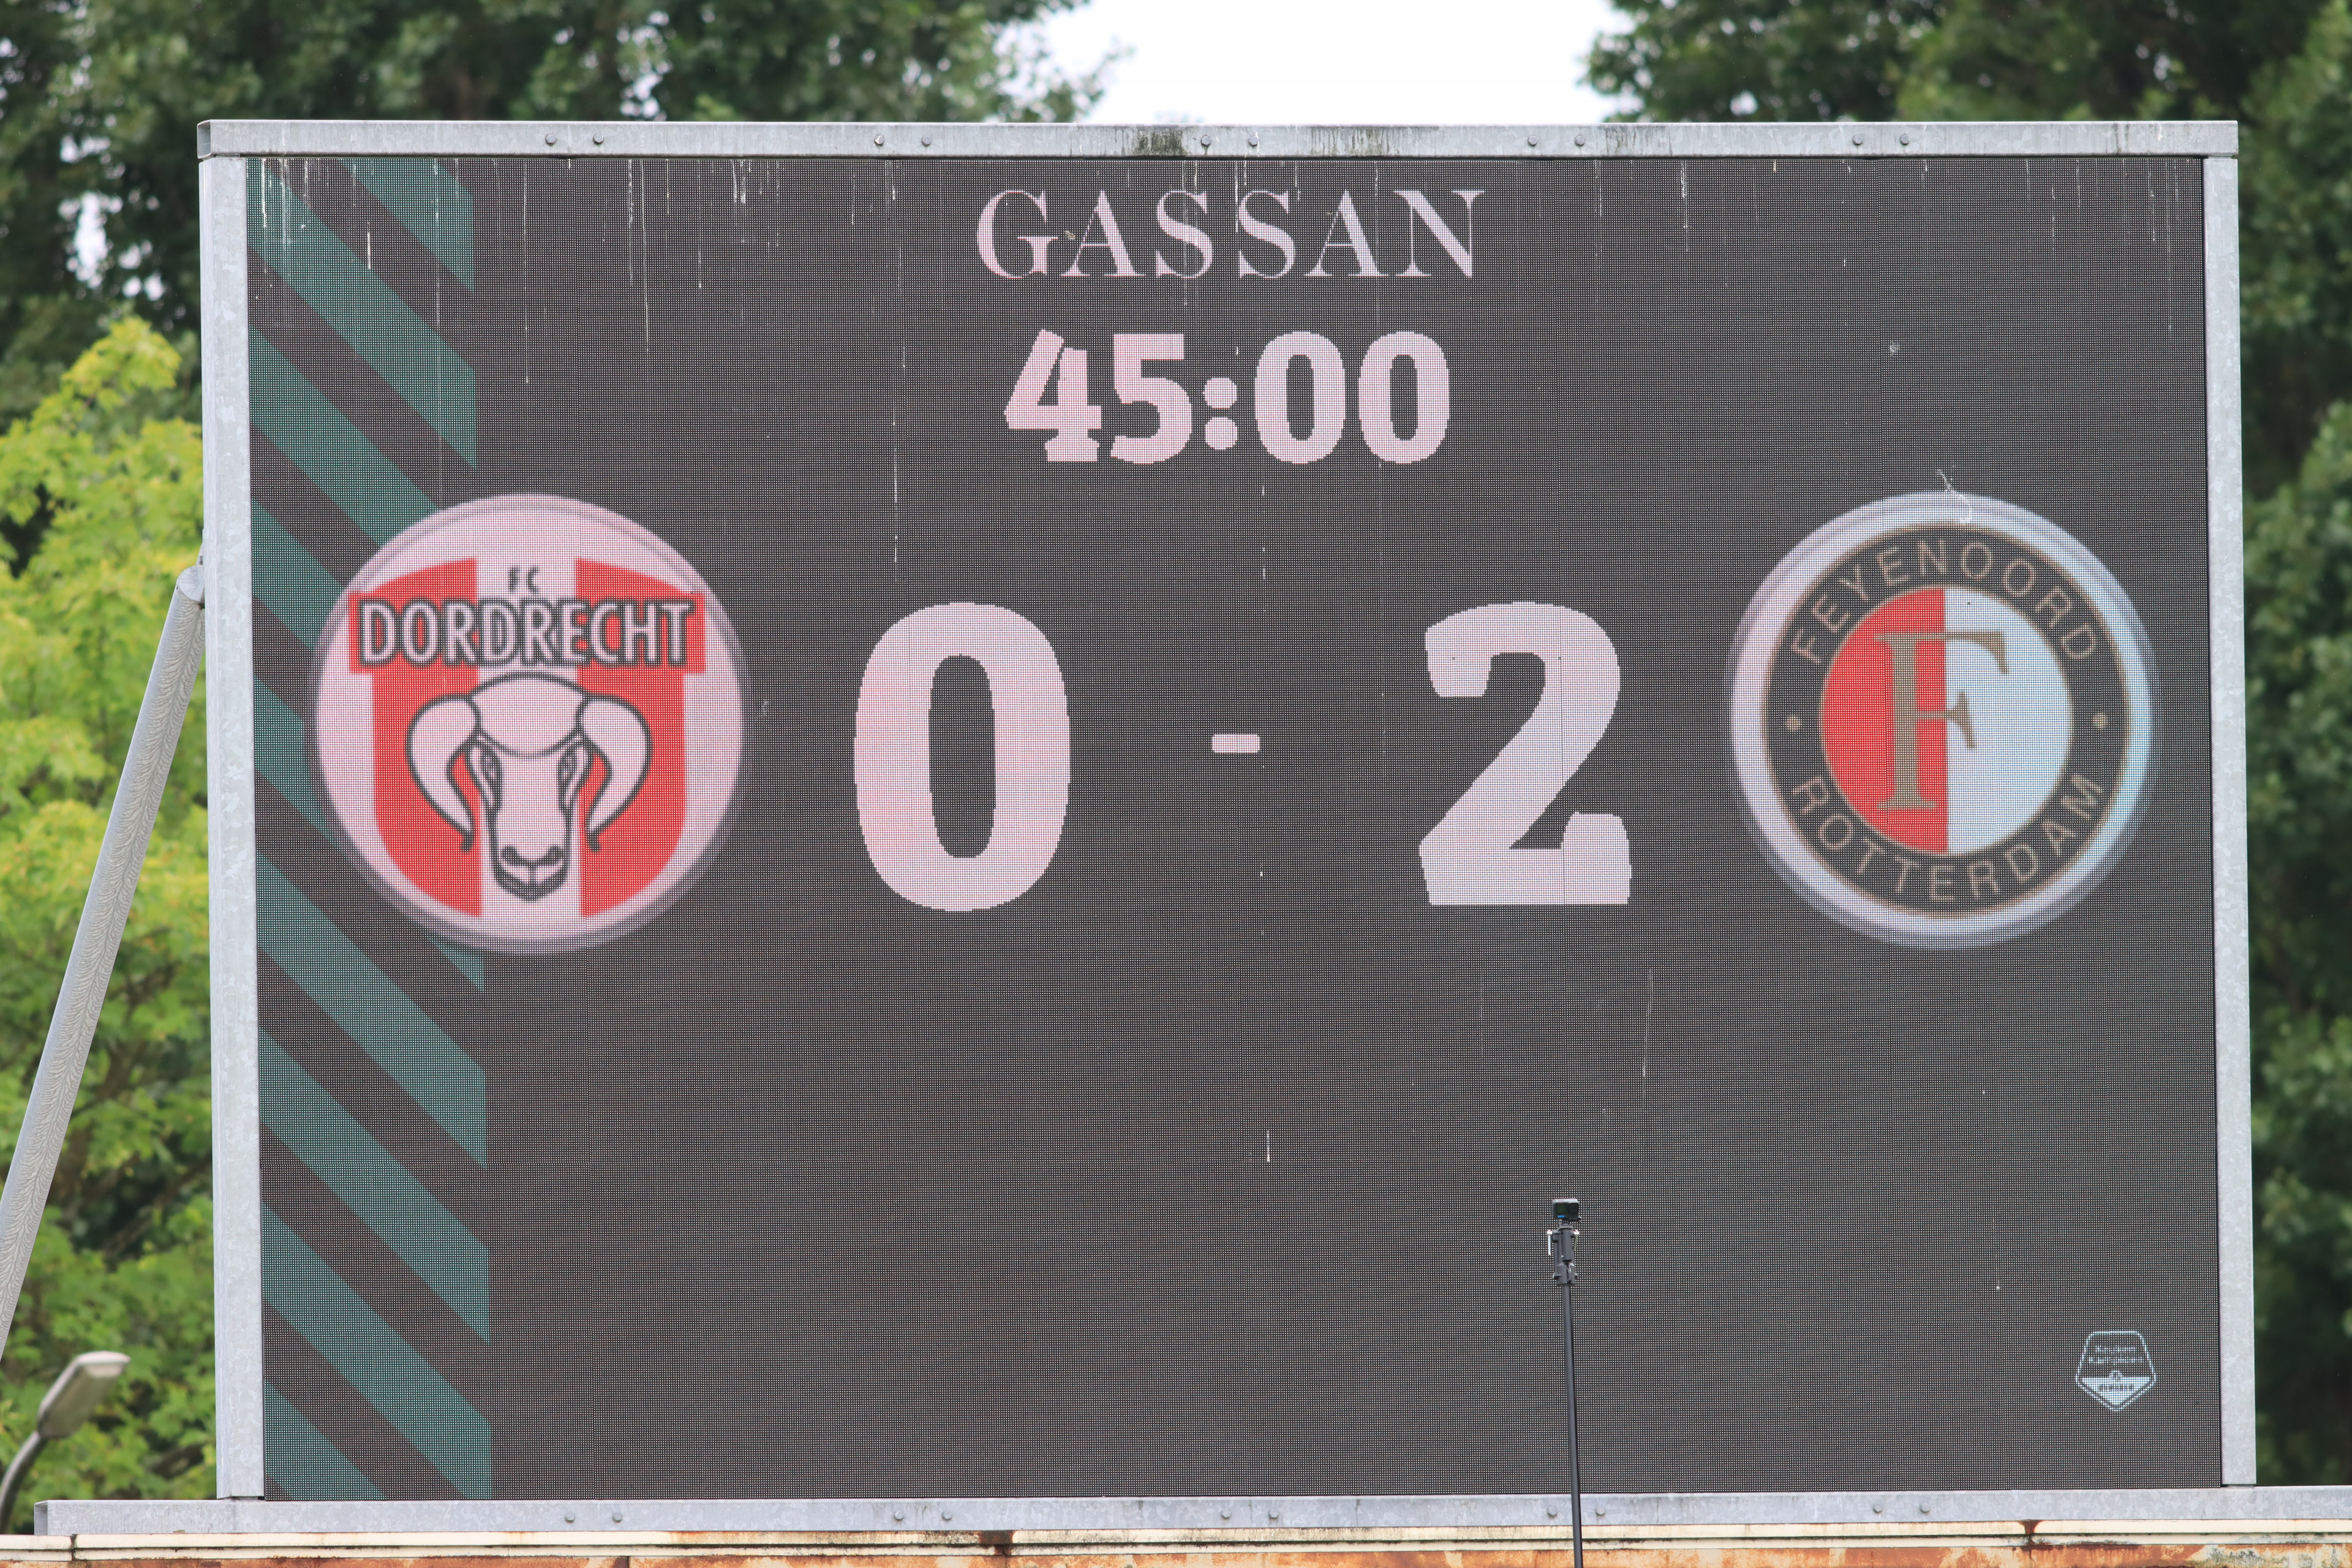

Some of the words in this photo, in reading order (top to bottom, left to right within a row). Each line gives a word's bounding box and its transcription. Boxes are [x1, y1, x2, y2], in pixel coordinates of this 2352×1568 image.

[977, 190, 1484, 279] GASSAN
[1003, 329, 1450, 464] 45:00
[359, 598, 696, 667] DORDRECHT
[508, 567, 539, 592] FC
[1790, 539, 2097, 665] FEYENOORD
[854, 601, 1071, 911] 0
[1419, 601, 1631, 906] 2
[1875, 631, 2010, 809] F
[1793, 774, 2103, 902] ROTTERDAM
